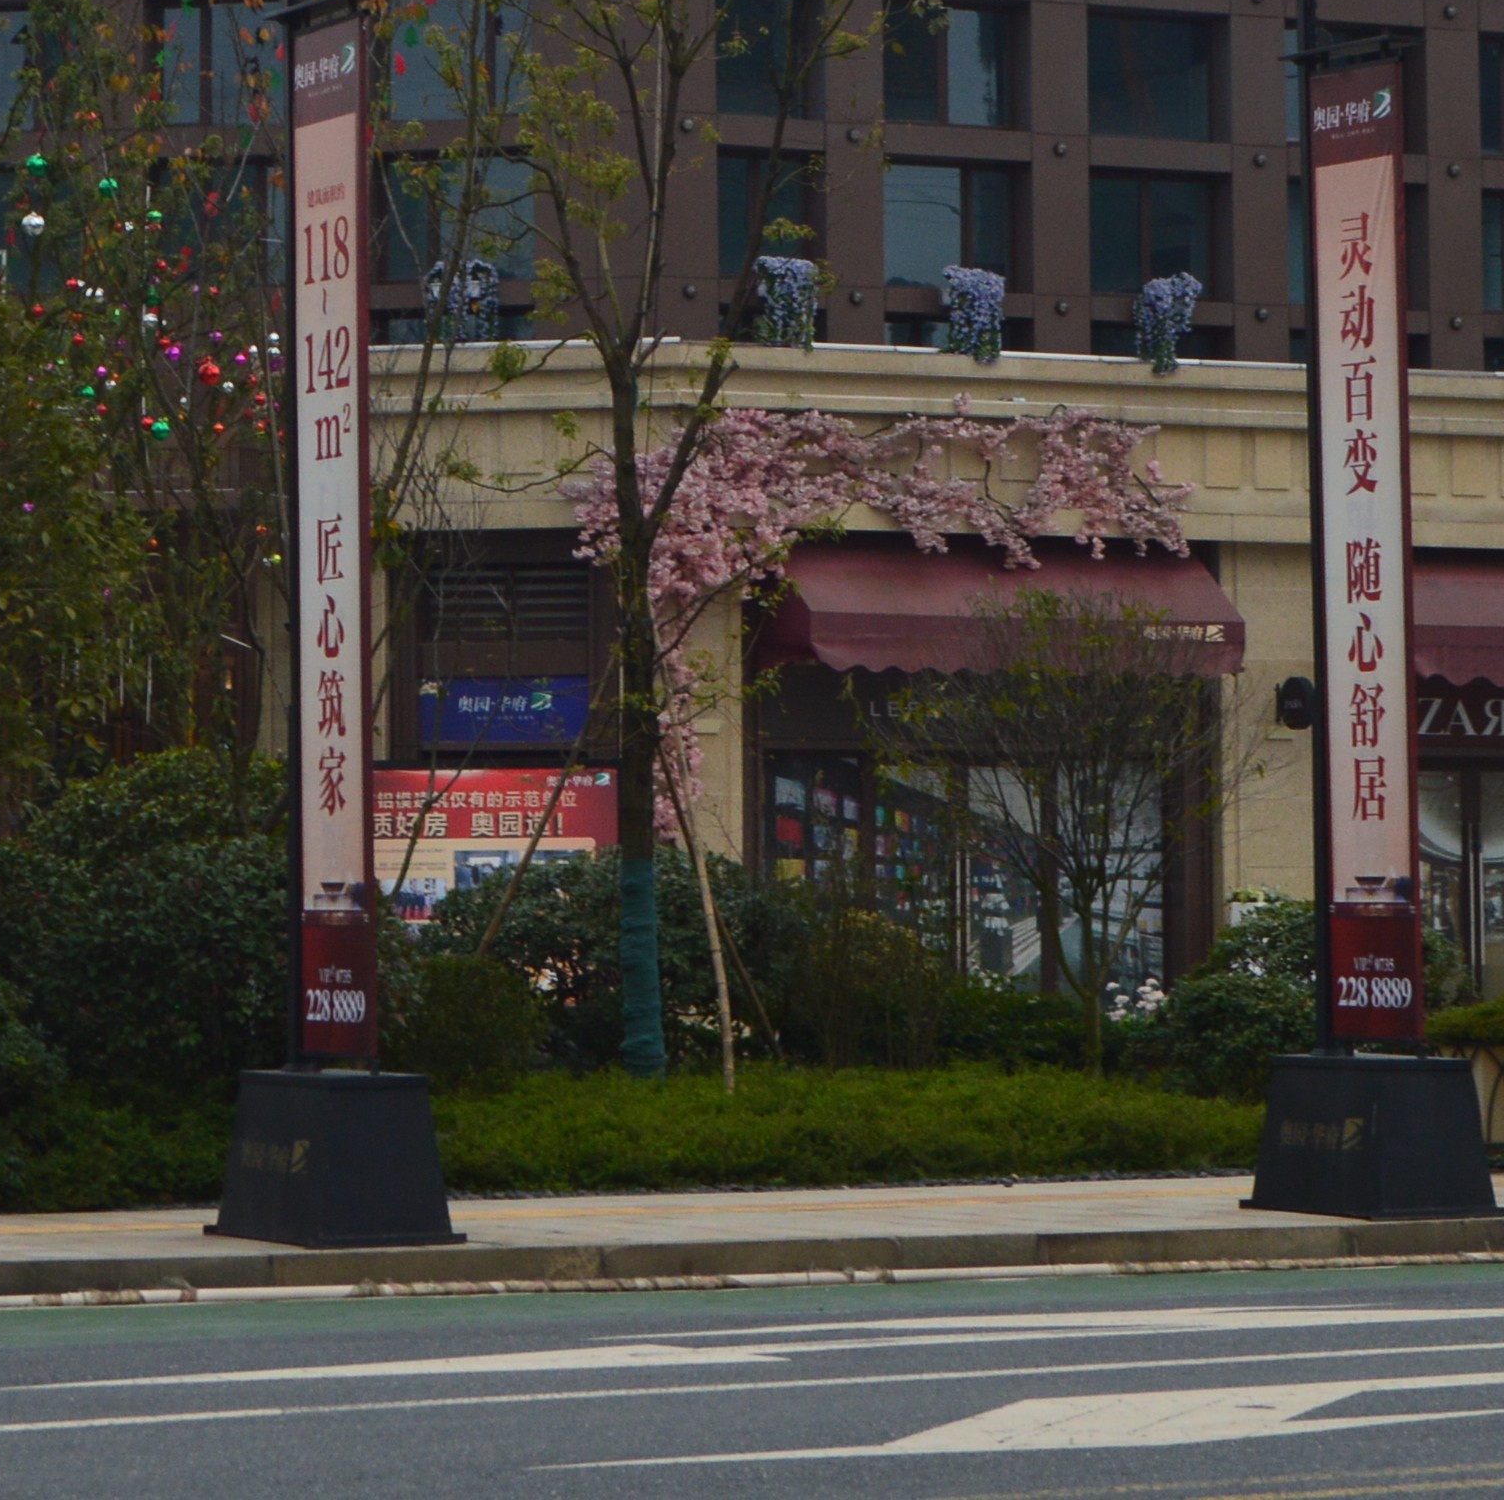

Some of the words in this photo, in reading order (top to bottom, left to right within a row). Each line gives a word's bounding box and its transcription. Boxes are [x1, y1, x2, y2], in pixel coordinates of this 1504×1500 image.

[1339, 212, 1379, 496] 灵动百变
[317, 513, 346, 816] 匠心筑家
[1346, 537, 1387, 821] 随心舒居
[306, 989, 331, 1021] 228
[332, 989, 366, 1023] 8889
[1337, 976, 1368, 1007] 228
[1371, 977, 1413, 1008] 8889
